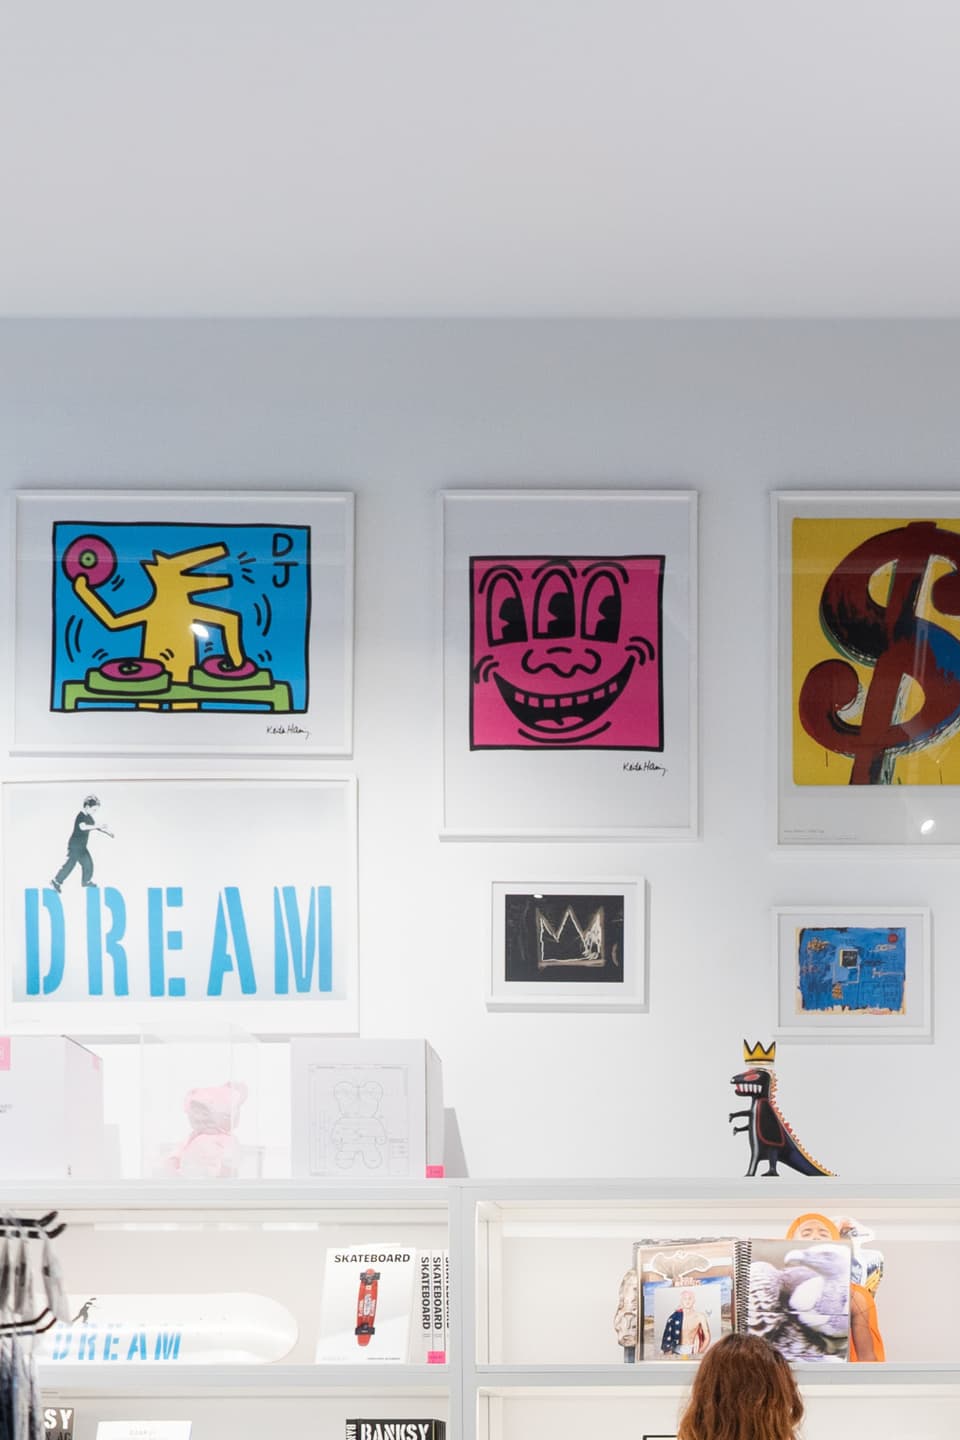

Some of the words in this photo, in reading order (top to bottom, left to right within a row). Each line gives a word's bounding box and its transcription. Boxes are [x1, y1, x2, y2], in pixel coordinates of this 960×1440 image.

[24, 885, 333, 996] DREAM
[334, 1253, 411, 1264] SKATEBOARD
[421, 1256, 431, 1330] SKATEBOARD
[433, 1256, 443, 1330] SKATEBOARD
